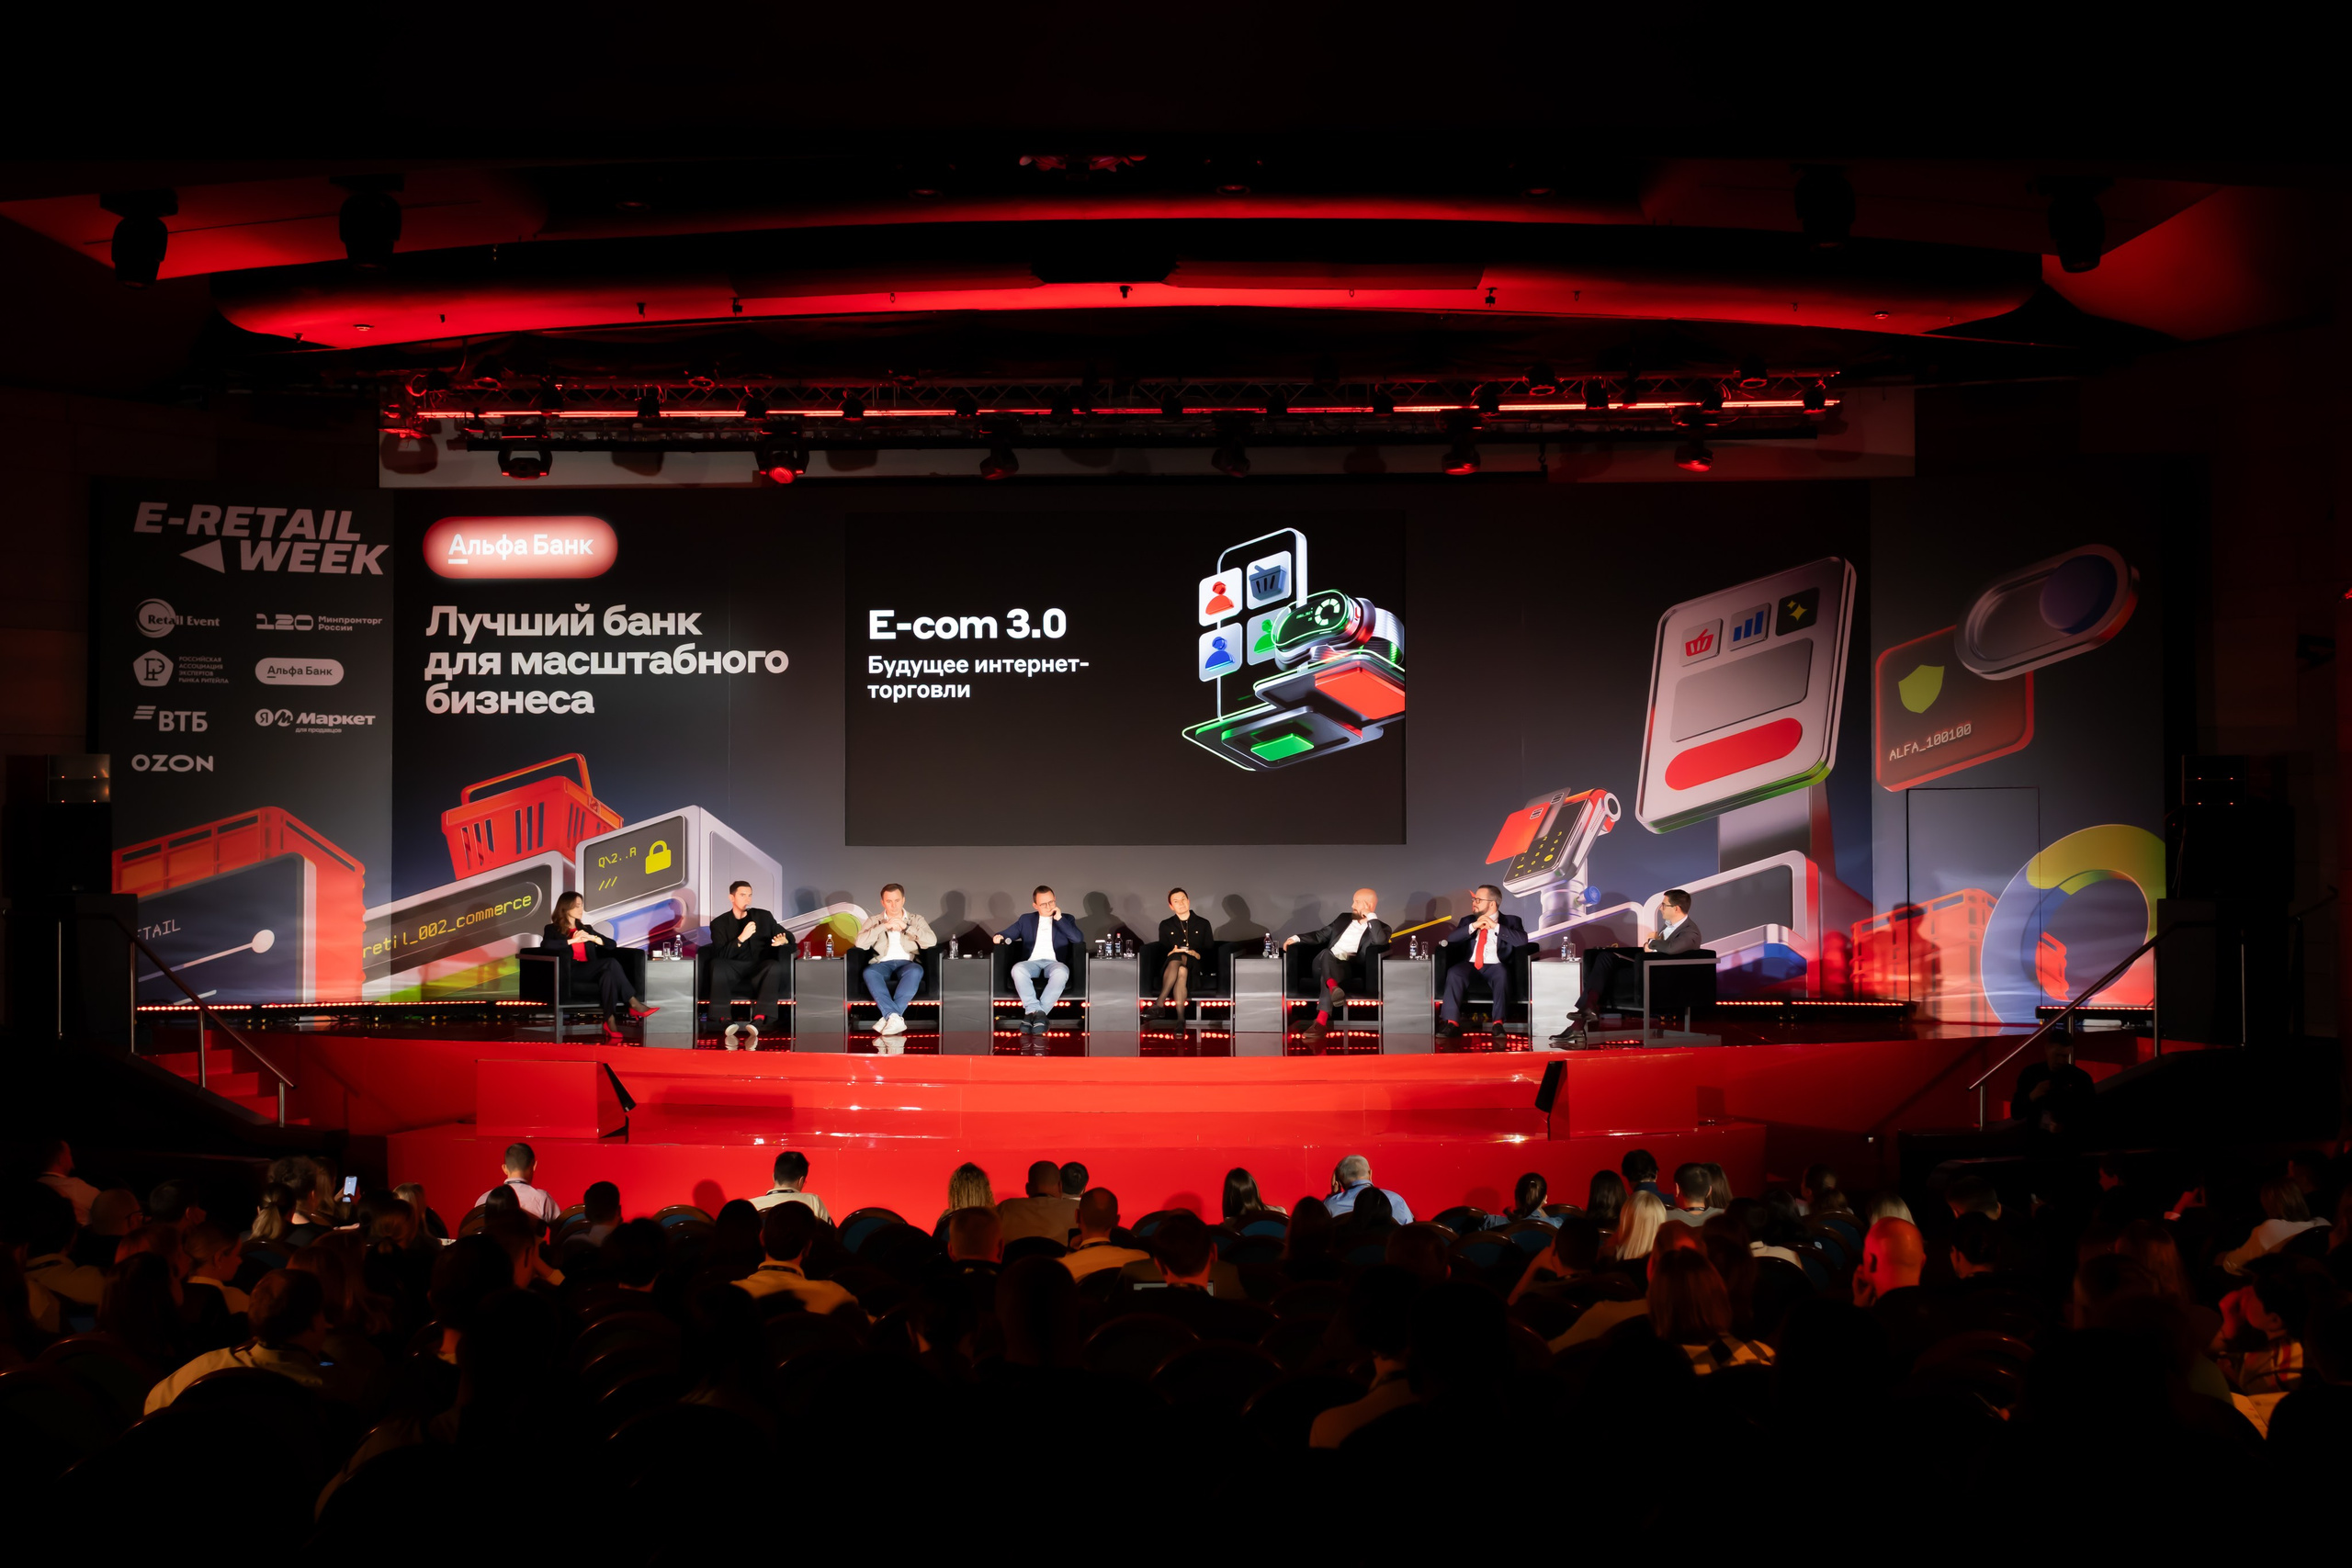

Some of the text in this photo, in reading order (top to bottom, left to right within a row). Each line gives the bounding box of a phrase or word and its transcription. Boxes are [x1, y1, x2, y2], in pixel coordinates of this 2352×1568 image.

[133, 502, 361, 541] E-RETAIL
[240, 539, 390, 575] WEEK
[447, 533, 594, 562] Альфа Банк
[147, 615, 220, 626] Retail Event
[255, 613, 314, 631] 120
[318, 615, 382, 625] Минпромторг
[425, 603, 703, 644] Лучший банк
[868, 607, 1067, 640] E-com 3.0
[266, 665, 333, 677] Альфа Банк
[424, 643, 789, 681] для масштабного
[867, 655, 1090, 678] Будущее интернет-
[425, 682, 595, 714] бизнеса
[867, 682, 970, 703] торговли
[158, 711, 208, 732] ВТБ
[296, 712, 376, 727] Маркет
[1889, 723, 1972, 761] ALFA_100100
[131, 754, 214, 773] OZON
